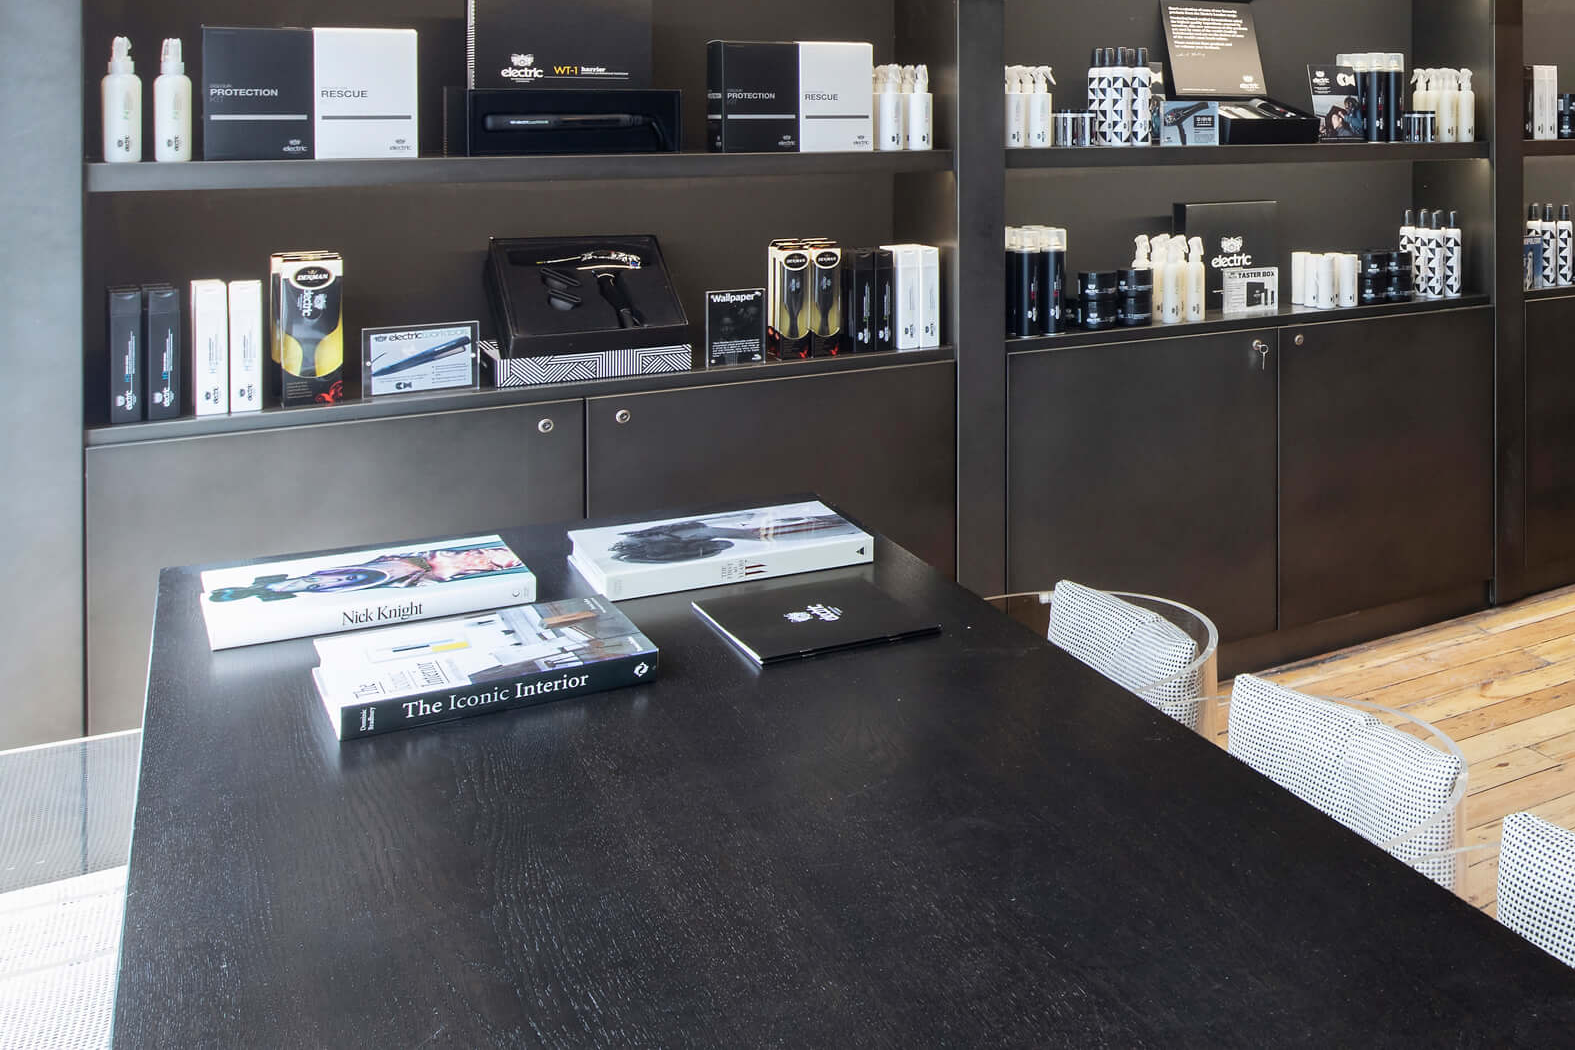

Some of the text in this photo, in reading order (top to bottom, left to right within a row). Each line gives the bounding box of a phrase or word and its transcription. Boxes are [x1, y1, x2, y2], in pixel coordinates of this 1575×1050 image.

[500, 66, 544, 78] electric
[553, 65, 579, 75] WT-1
[209, 88, 279, 97] PROTECTION
[320, 90, 369, 98] RESCUE
[727, 92, 776, 100] PROTECTION
[804, 93, 839, 101] RESCUE
[282, 144, 309, 152] electric
[1211, 252, 1252, 268] electric
[1238, 271, 1262, 279] TASTER
[342, 600, 424, 626] Nick Knight
[402, 673, 590, 719] The Iconic Interior
